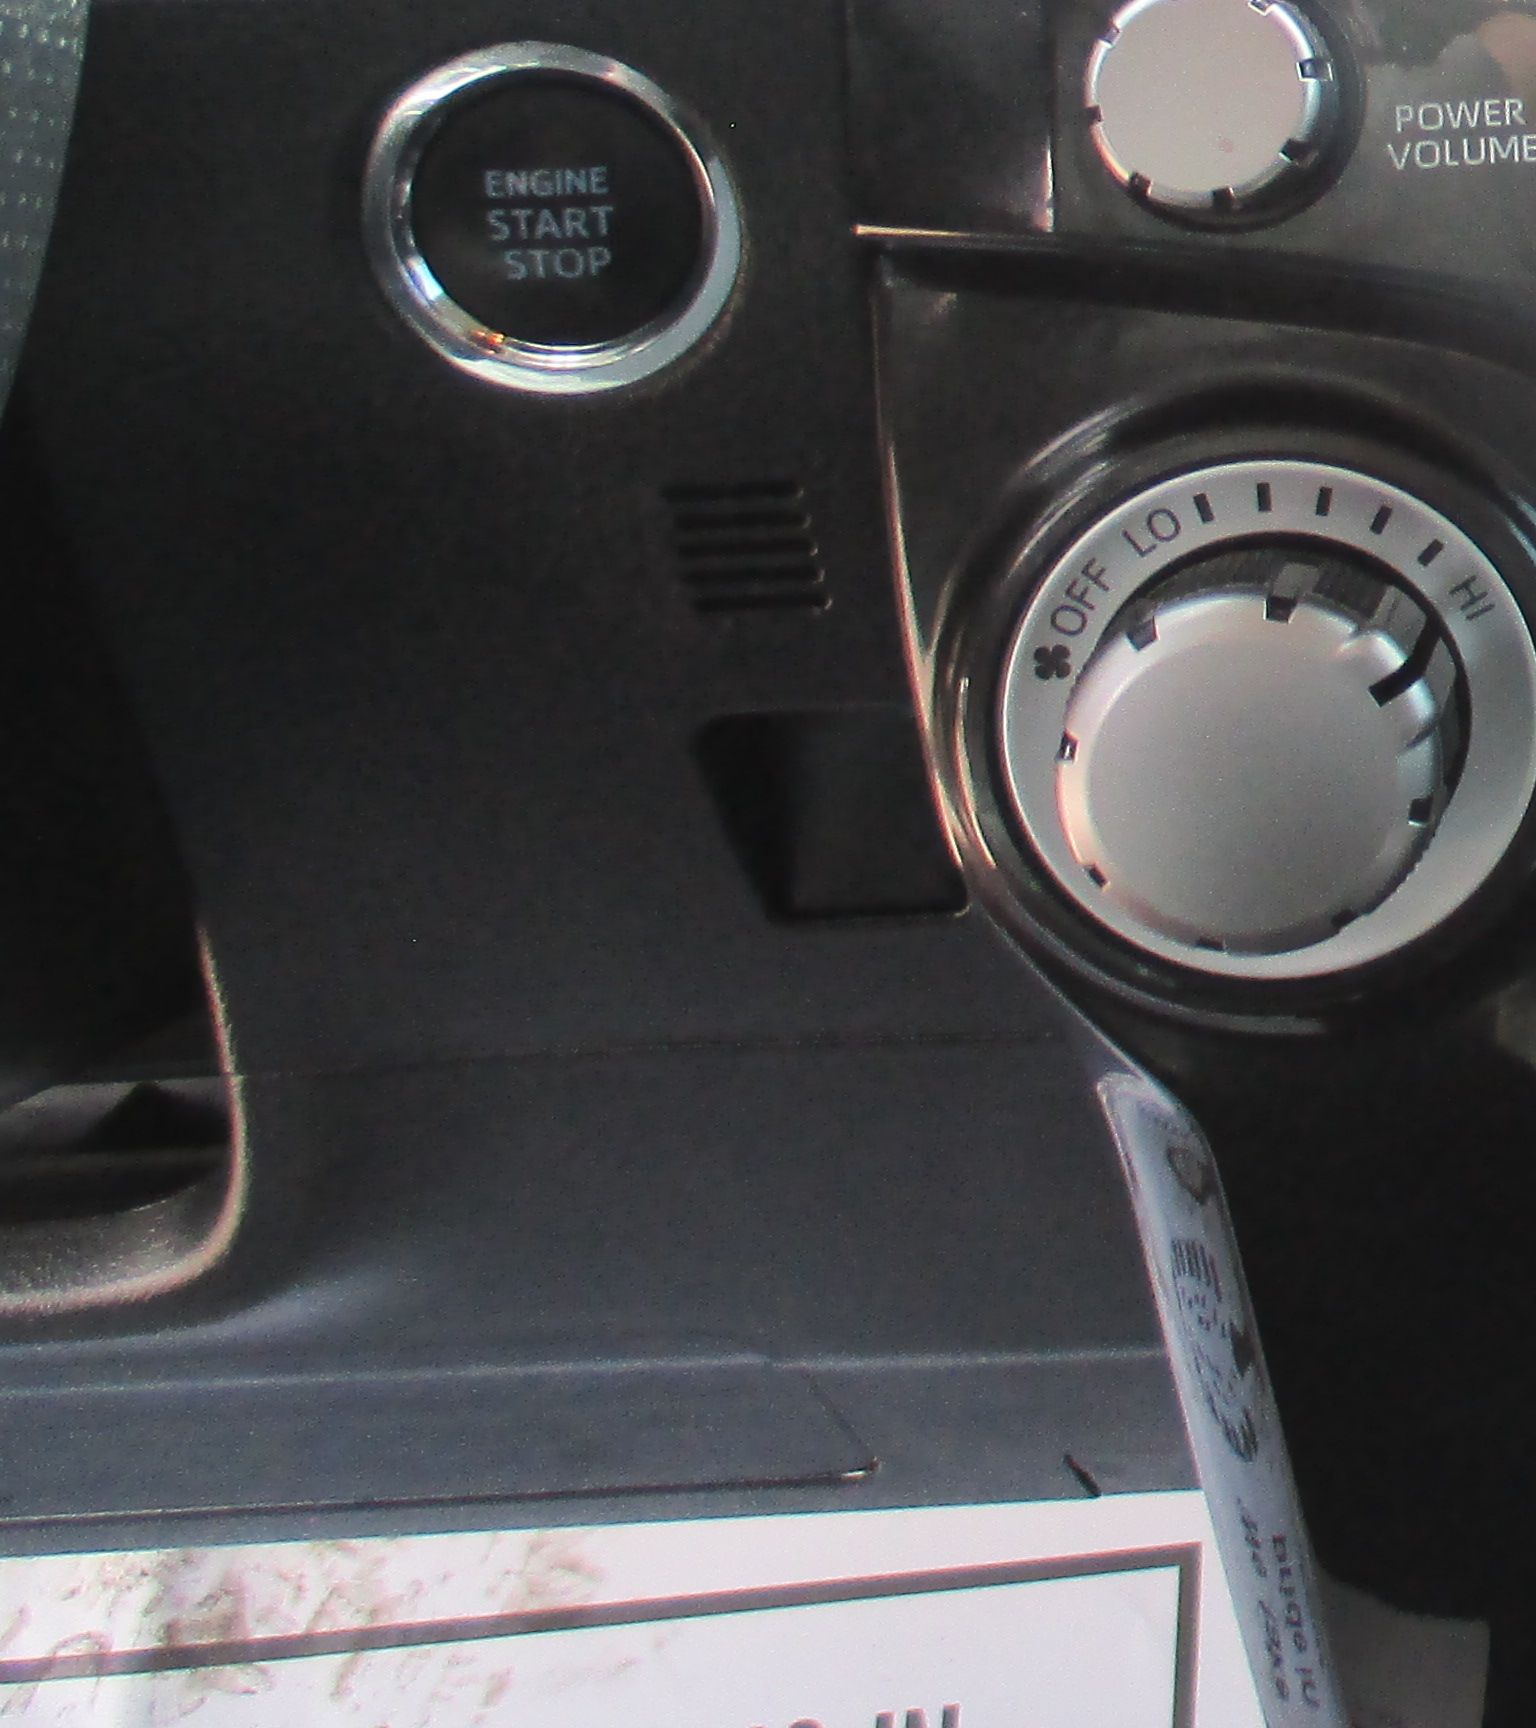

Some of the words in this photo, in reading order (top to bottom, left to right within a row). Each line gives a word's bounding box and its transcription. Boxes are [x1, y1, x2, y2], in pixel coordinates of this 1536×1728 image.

[1395, 97, 1527, 133] POWER
[484, 165, 608, 198] ENGINE
[486, 205, 614, 242] START
[504, 246, 612, 282] STOP
[1050, 558, 1111, 637] OFF
[1121, 507, 1183, 558] LO
[1448, 574, 1496, 622] HI
